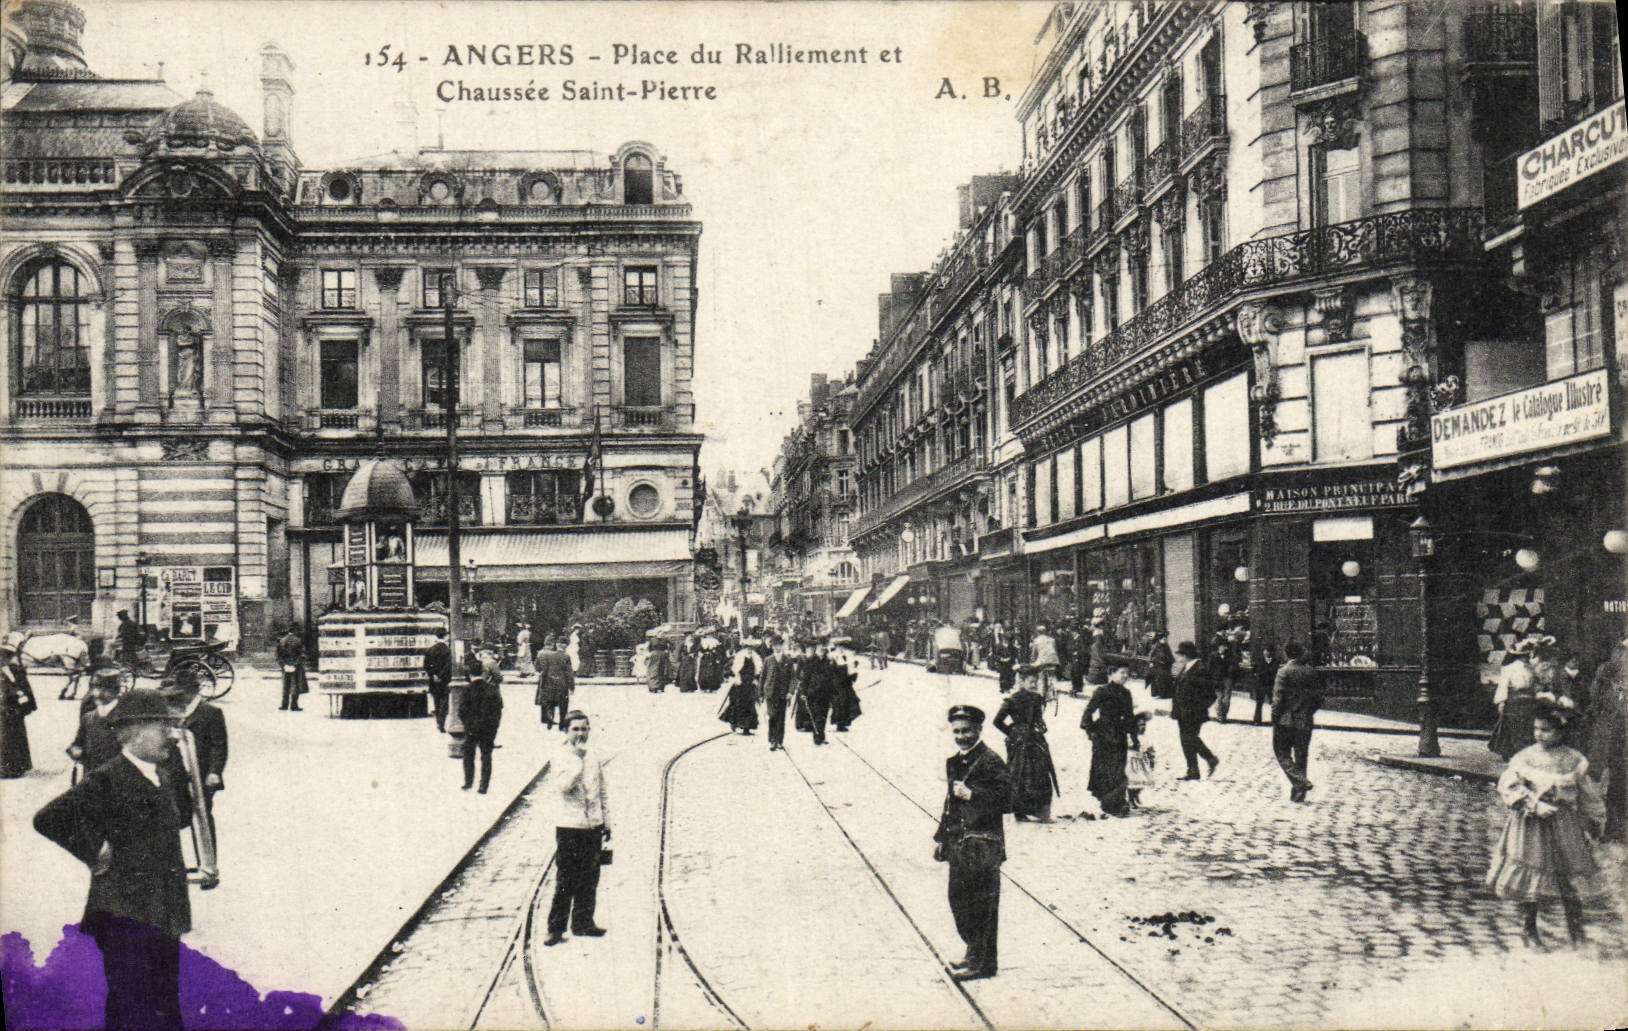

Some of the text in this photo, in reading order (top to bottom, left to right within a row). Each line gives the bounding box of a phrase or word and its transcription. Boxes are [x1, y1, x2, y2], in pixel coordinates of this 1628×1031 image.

[1433, 401, 1507, 444] DEMANDEZ
[1523, 391, 1564, 421] Catalogue
[498, 456, 577, 471] FRANCE
[1265, 486, 1319, 500] MAISON
